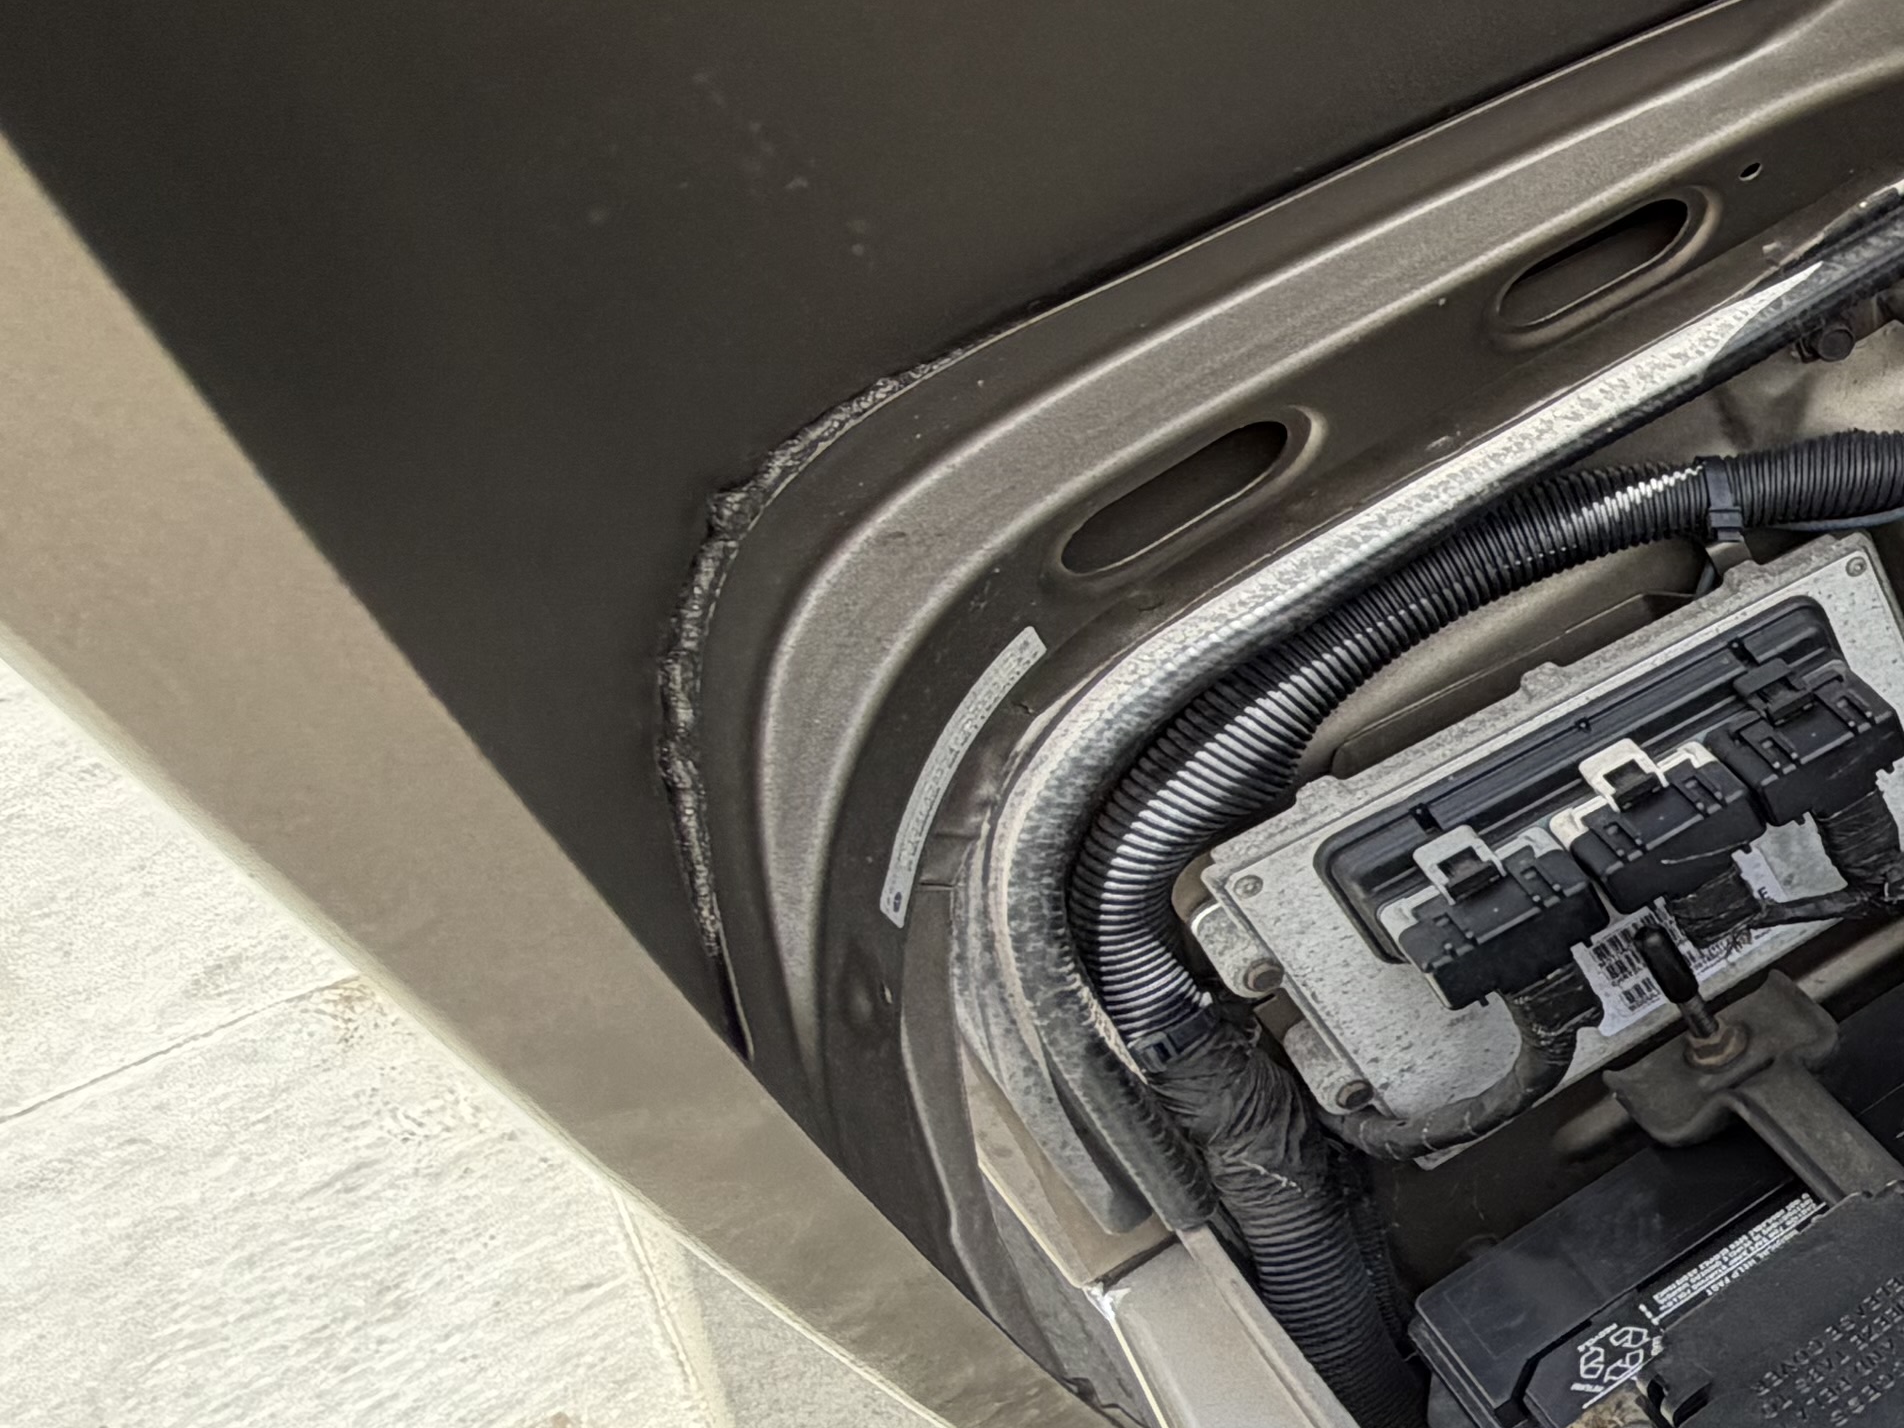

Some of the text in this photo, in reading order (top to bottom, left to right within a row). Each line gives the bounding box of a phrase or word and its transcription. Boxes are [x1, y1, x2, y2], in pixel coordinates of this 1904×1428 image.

[1704, 1257, 1756, 1296] HELP FAST
[1748, 1336, 1827, 1398] COVER
[1790, 1347, 1851, 1395] TABS
[1849, 1337, 1901, 1379] AND
[1756, 1391, 1793, 1421] TO
